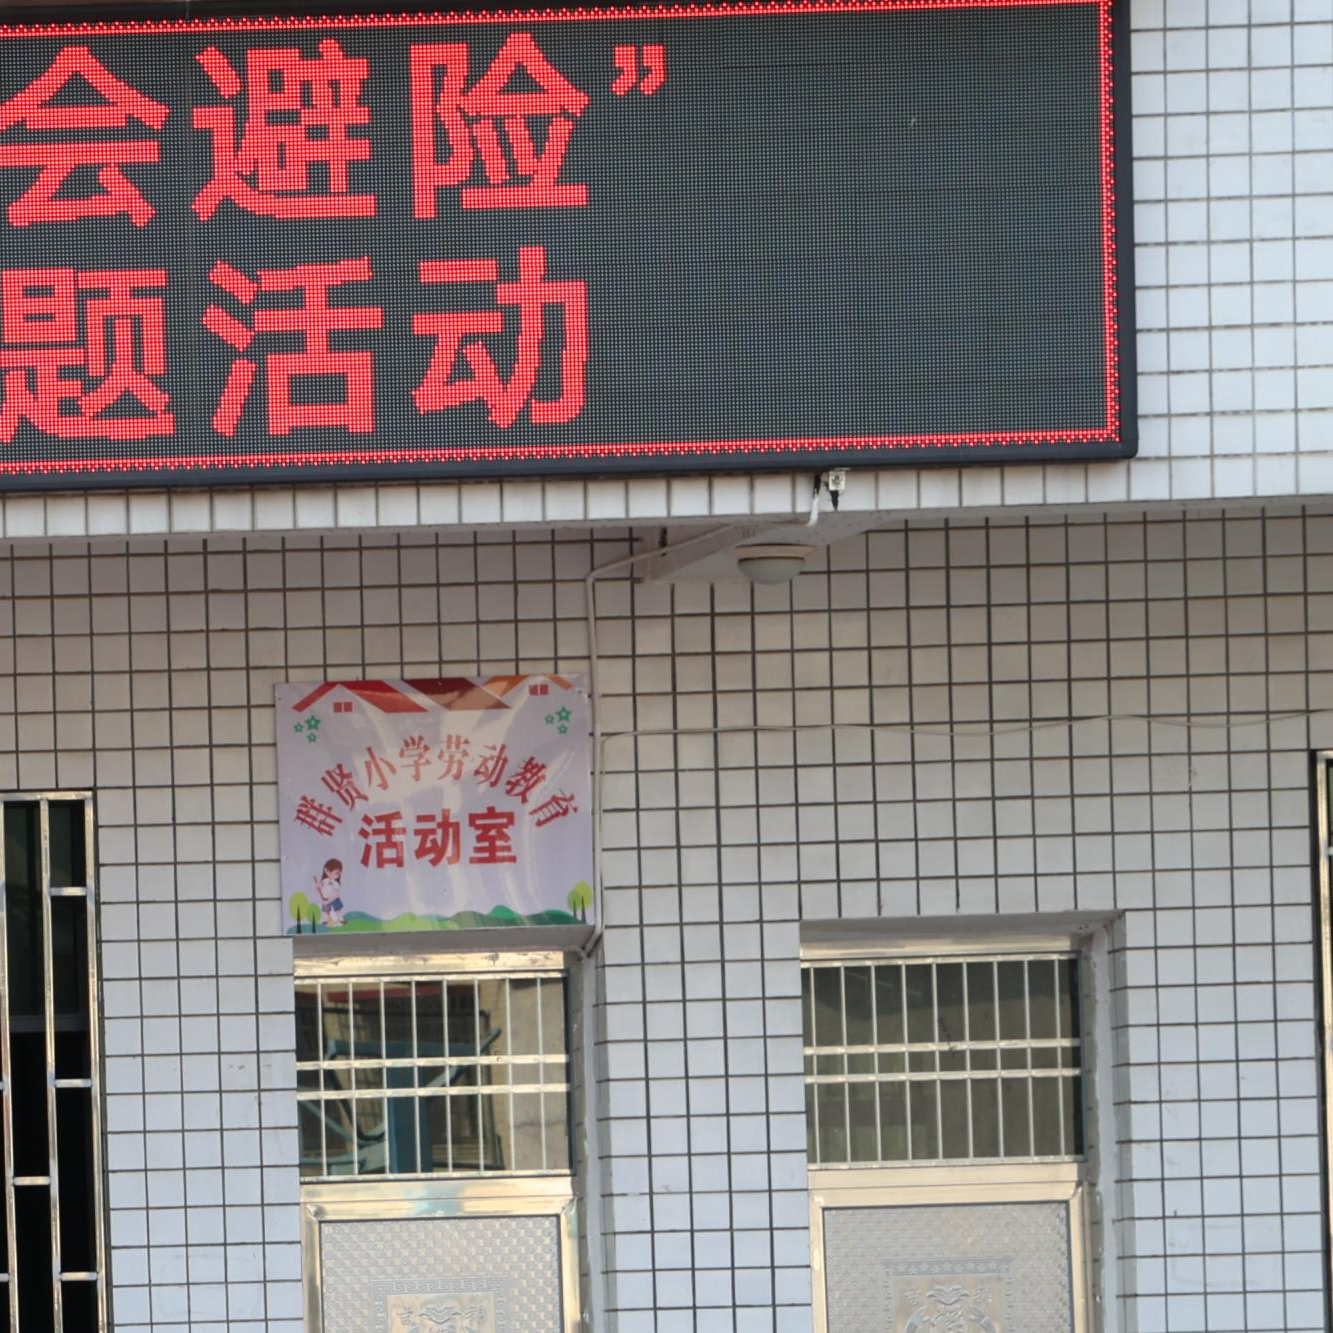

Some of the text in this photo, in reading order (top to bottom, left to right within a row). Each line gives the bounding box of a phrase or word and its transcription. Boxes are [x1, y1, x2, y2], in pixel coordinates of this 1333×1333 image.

[293, 733, 579, 838] 群贤小学劳动教育
[357, 805, 518, 869] 活动室
